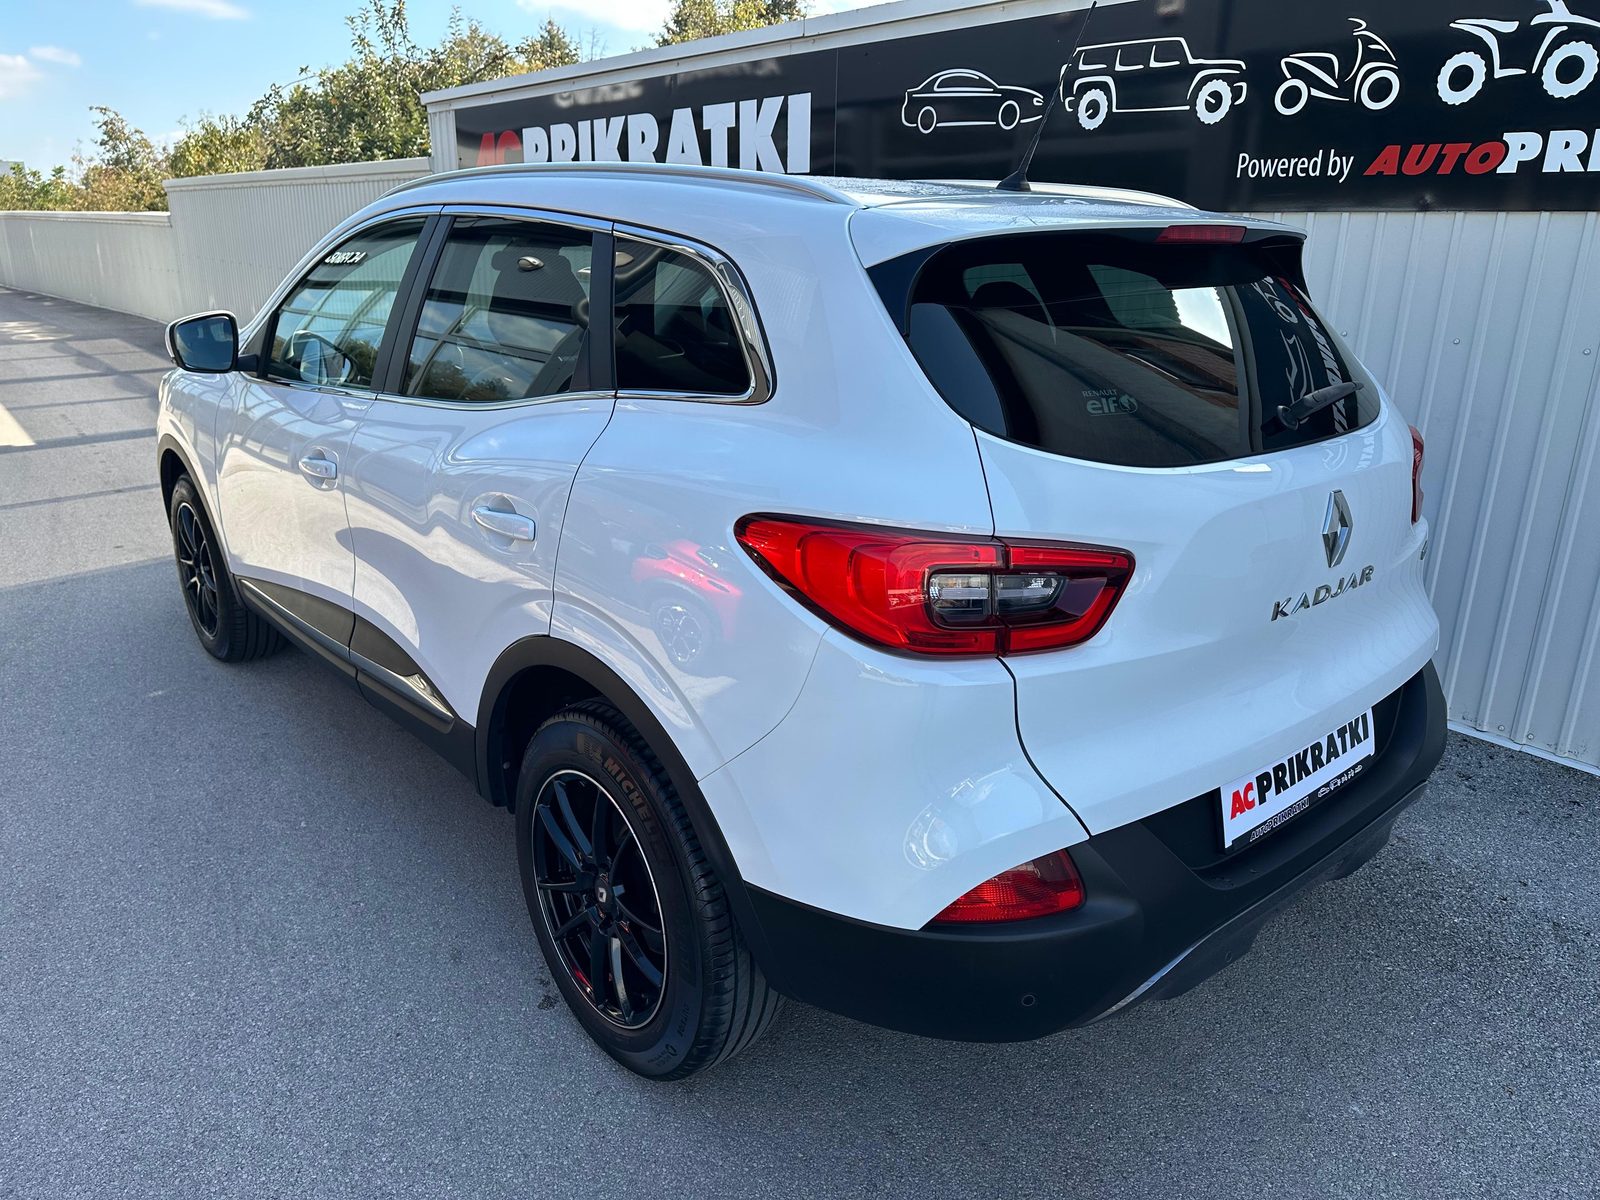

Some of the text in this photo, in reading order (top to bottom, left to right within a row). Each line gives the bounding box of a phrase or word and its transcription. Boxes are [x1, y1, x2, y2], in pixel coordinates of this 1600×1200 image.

[1236, 149, 1322, 178] Powered
[1327, 149, 1354, 183] by
[1082, 389, 1117, 398] RENAULT
[1086, 397, 1118, 414] elf
[1271, 565, 1374, 621] KADJAR
